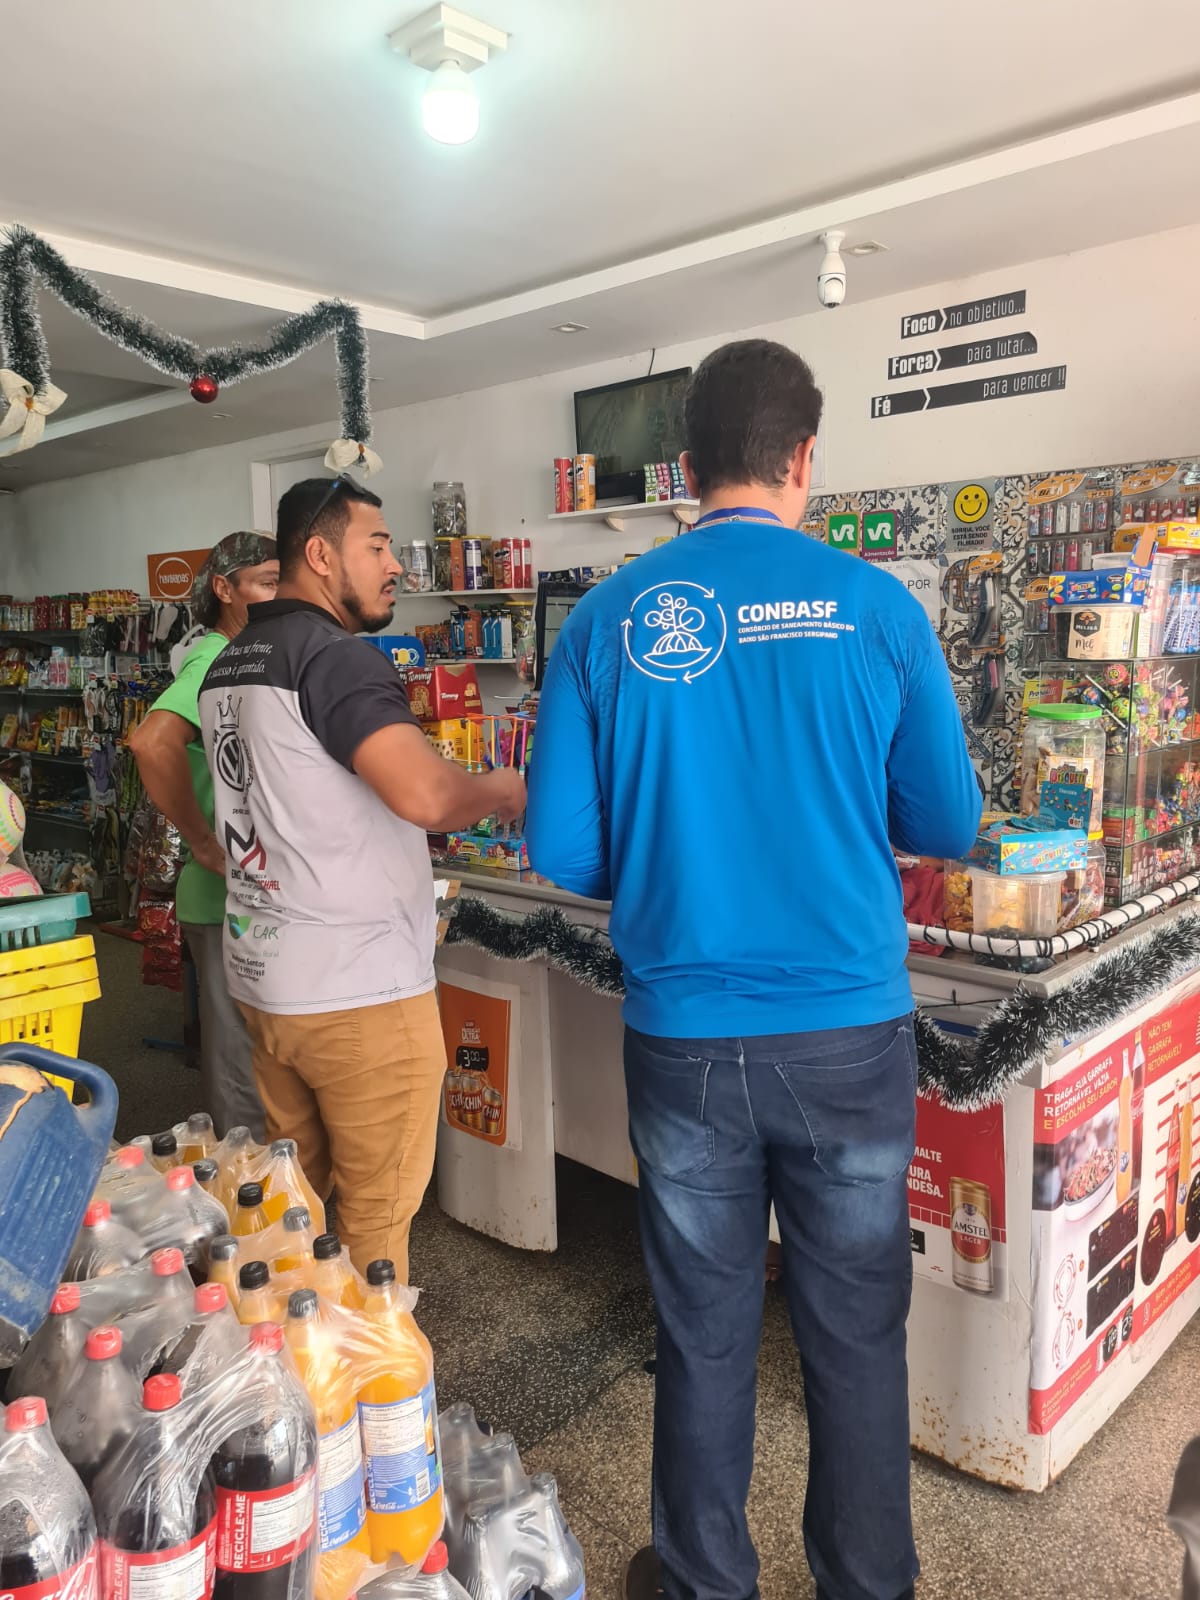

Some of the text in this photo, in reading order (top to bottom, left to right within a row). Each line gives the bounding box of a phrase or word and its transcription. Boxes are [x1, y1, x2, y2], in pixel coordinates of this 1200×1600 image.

[903, 299, 1025, 336] Foco no objetivo...
[891, 339, 1035, 376] Força para lutar...
[874, 395, 891, 417] Fé
[983, 379, 1008, 398] para
[1013, 371, 1053, 393] vencer
[907, 579, 931, 590] POR
[737, 601, 838, 624] CONBASF
[738, 624, 771, 634] CONSÓRCIO
[781, 621, 822, 630] SANEAMENTO
[823, 621, 845, 630] BÁSICO
[846, 624, 855, 632] DO
[758, 633, 769, 641] SÃO
[770, 631, 803, 640] FRANCISCO
[804, 631, 838, 639] SERGIPANO
[253, 925, 279, 940] CAR
[1148, 1020, 1172, 1040] NÃO TEM
[1044, 1056, 1113, 1104] TRAGA SUA GARRAFA
[1044, 1072, 1110, 1117] RETORNÁVEL VAZIA
[1056, 1103, 1086, 1129] ESCOLHA
[1086, 1093, 1099, 1108] SEU
[1099, 1078, 1119, 1098] SABOR
[954, 1221, 988, 1237] AMSTEL
[960, 1235, 981, 1244] LAGER
